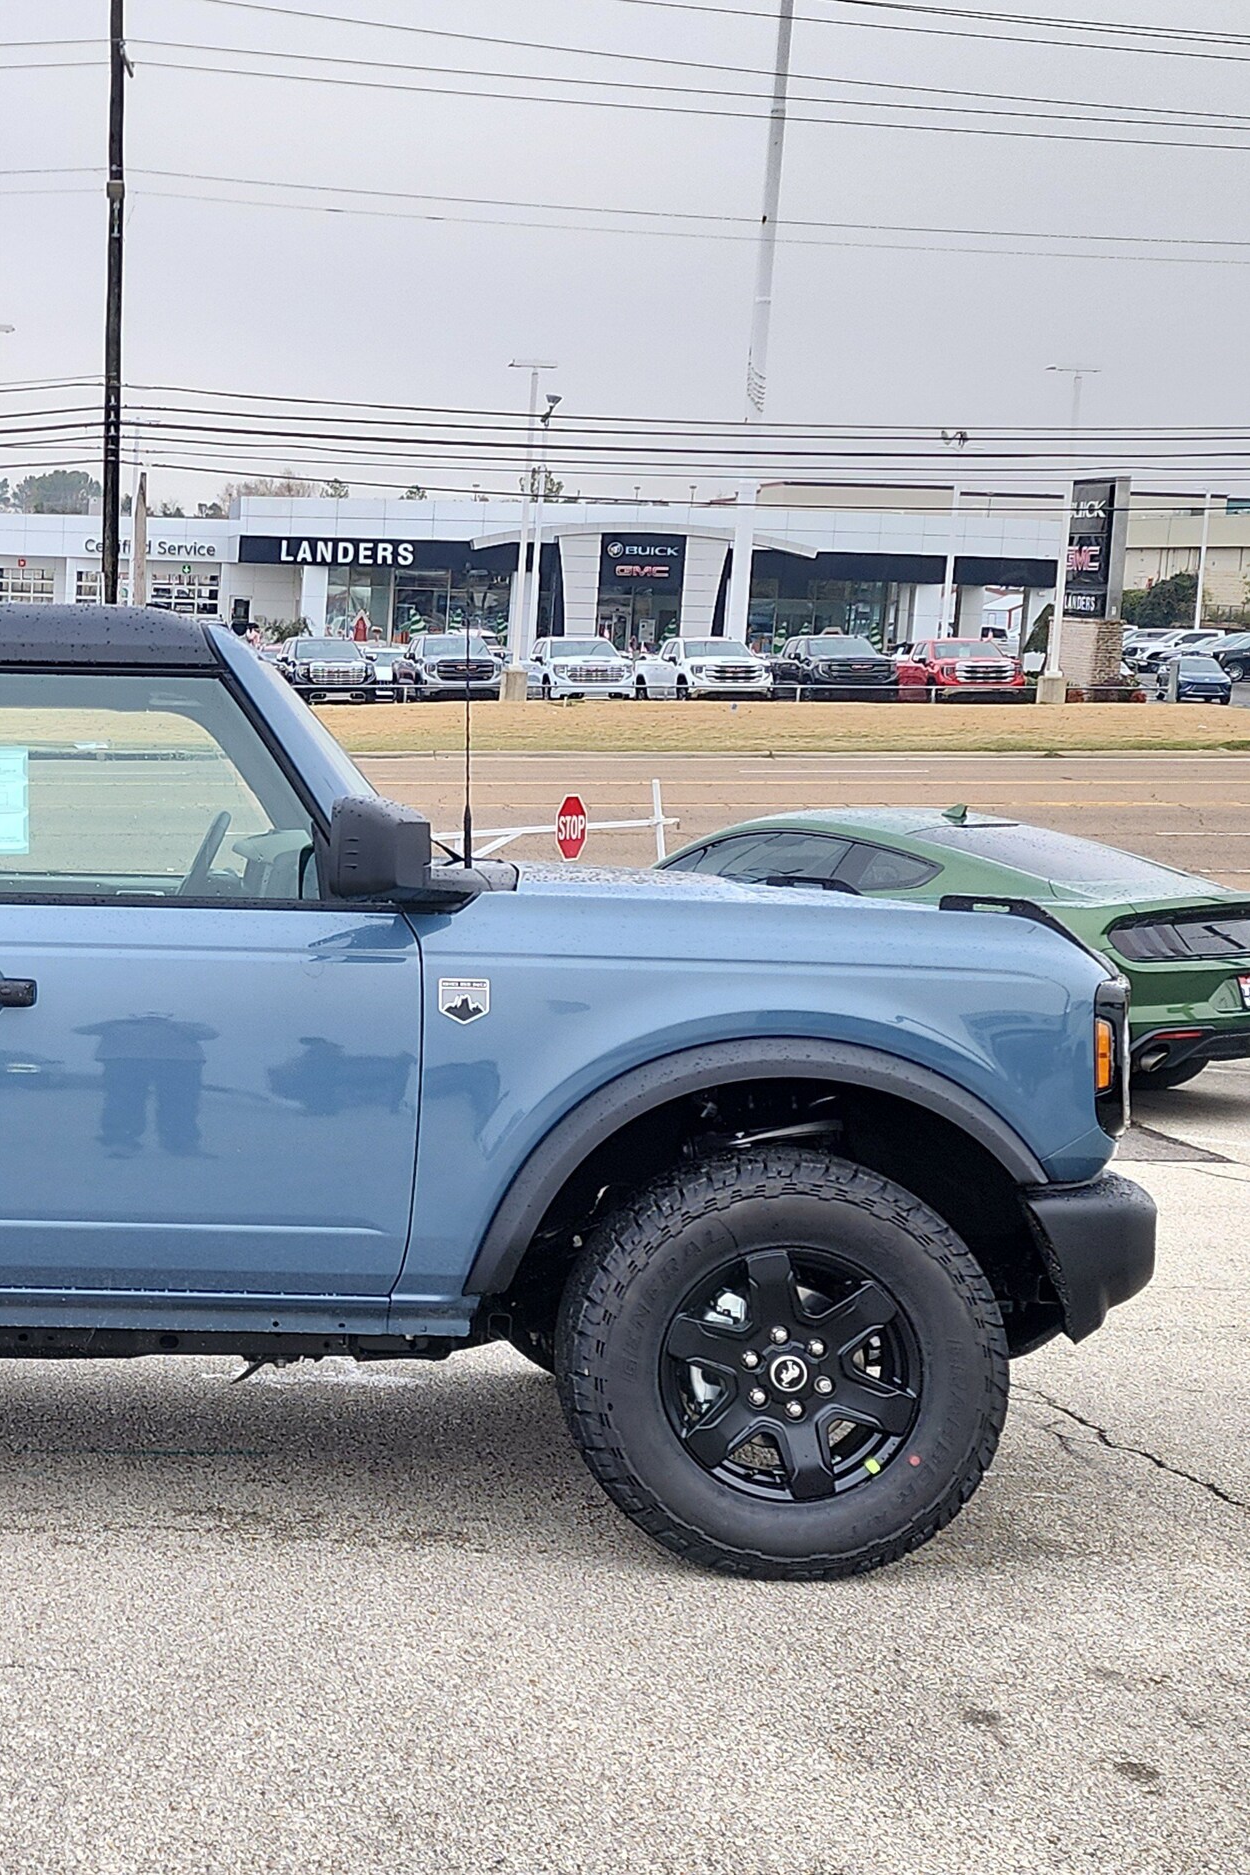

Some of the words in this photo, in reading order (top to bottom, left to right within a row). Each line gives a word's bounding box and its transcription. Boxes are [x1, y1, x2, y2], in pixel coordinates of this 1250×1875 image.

[158, 541, 215, 556] Service
[280, 540, 414, 566] LANDERS
[625, 546, 679, 556] BUICK
[1067, 546, 1101, 571] GMC
[616, 565, 669, 577] GMC
[1065, 595, 1096, 612] LANDERS
[558, 815, 585, 840] STOP
